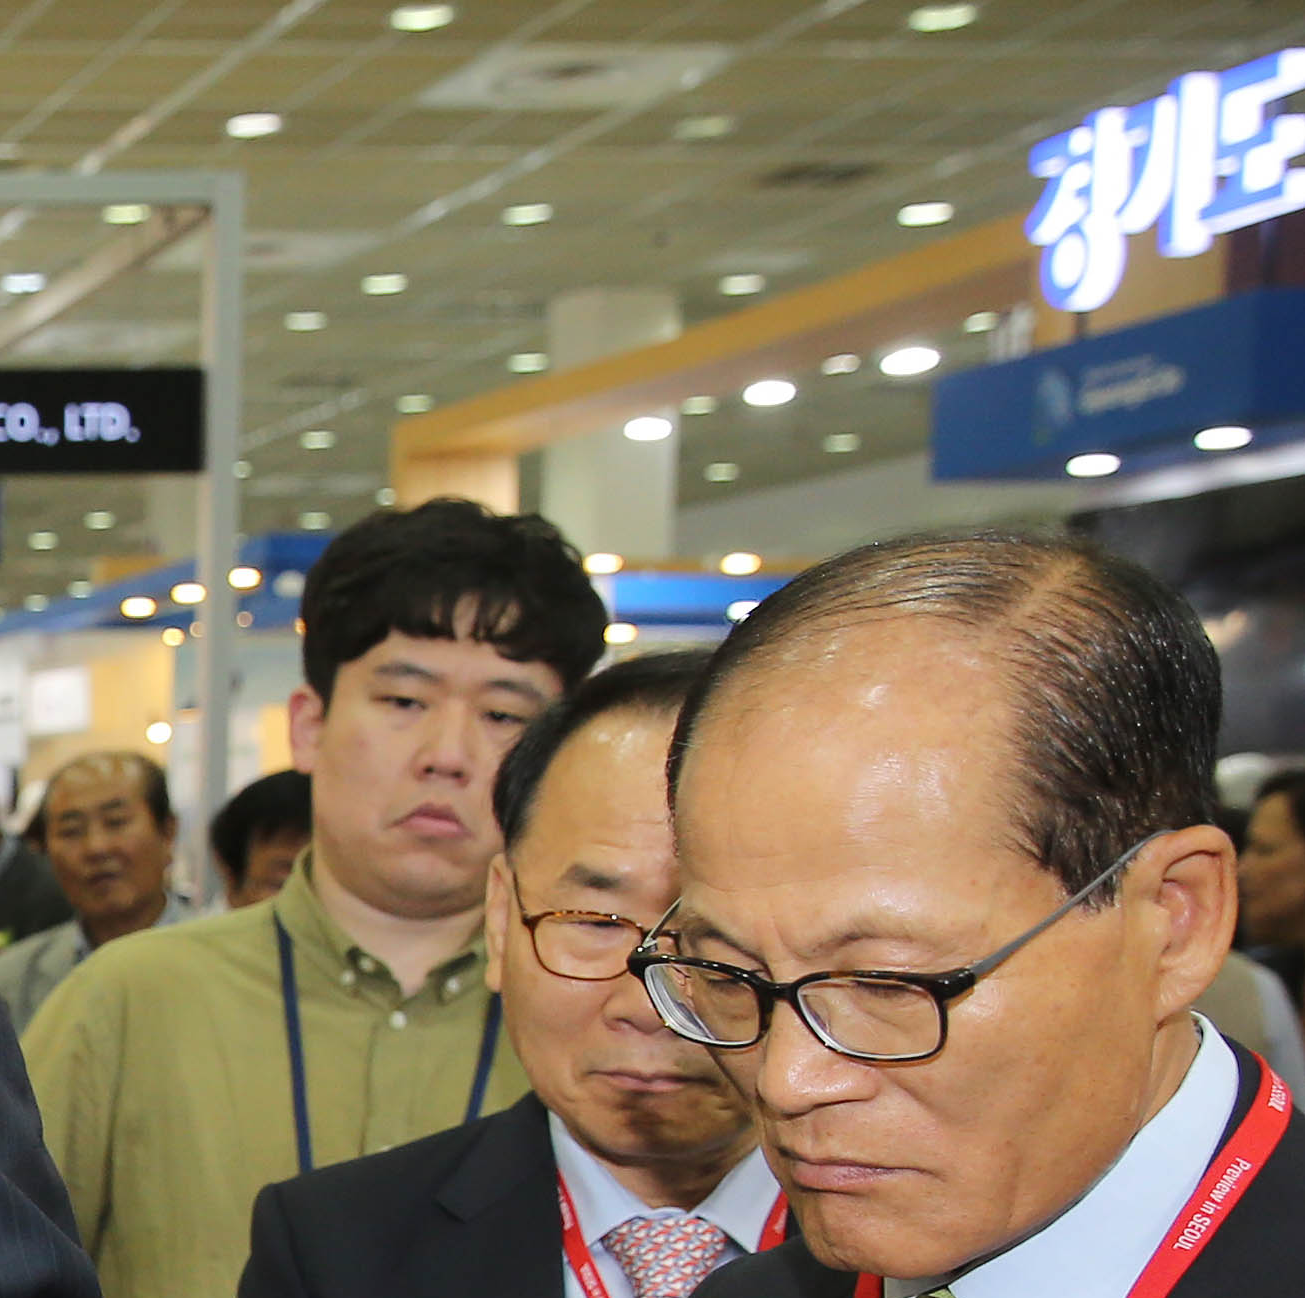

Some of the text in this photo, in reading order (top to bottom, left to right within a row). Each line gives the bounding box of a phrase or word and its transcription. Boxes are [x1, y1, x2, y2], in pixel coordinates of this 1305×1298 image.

[63, 401, 141, 443] LTD.
[1172, 1157, 1252, 1250] Preview in SEOUL
